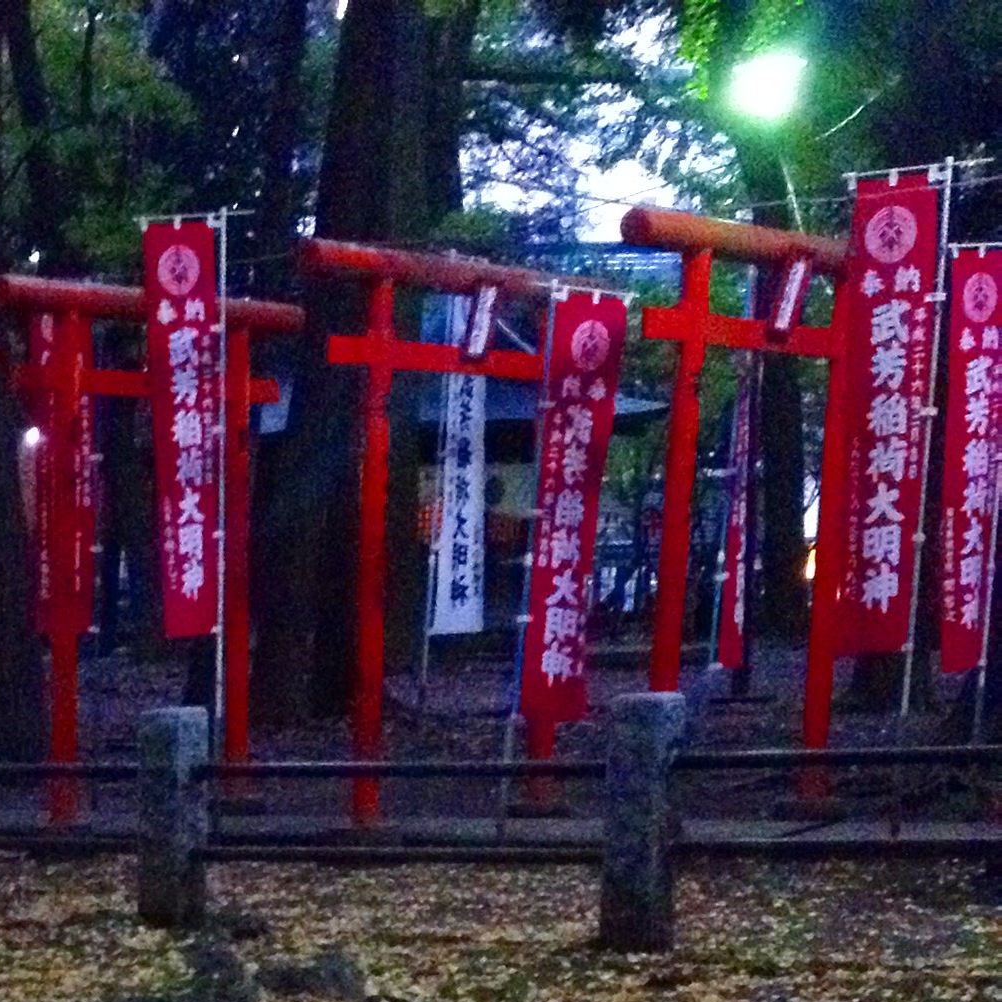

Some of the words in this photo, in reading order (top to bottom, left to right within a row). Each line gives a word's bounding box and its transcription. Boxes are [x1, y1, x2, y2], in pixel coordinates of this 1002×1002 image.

[168, 326, 206, 602] 武芳稲荷大明神
[860, 299, 911, 614] 武芳稲荷大明神
